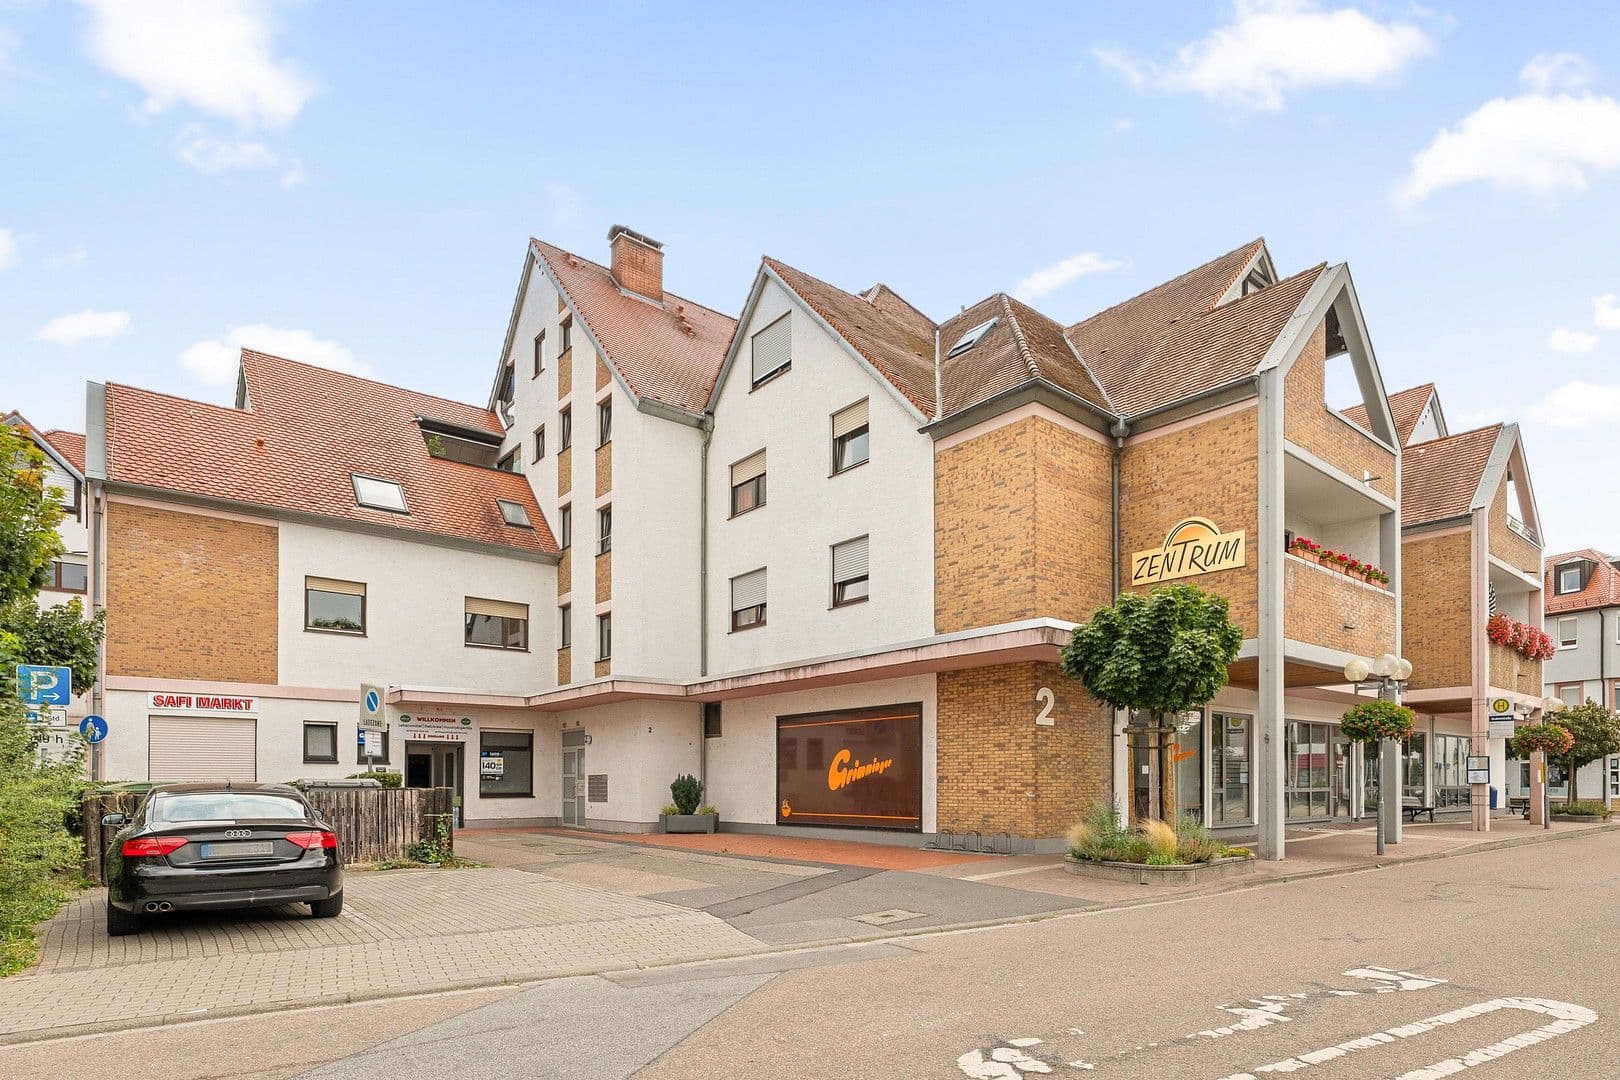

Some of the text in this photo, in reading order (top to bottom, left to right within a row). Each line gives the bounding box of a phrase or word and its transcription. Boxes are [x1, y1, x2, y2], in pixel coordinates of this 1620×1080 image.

[1133, 538, 1241, 581] ZENTRUM
[30, 671, 58, 700] P
[152, 695, 254, 711] SAFI MARKT
[1035, 687, 1055, 726] 2
[55, 734, 64, 744] h
